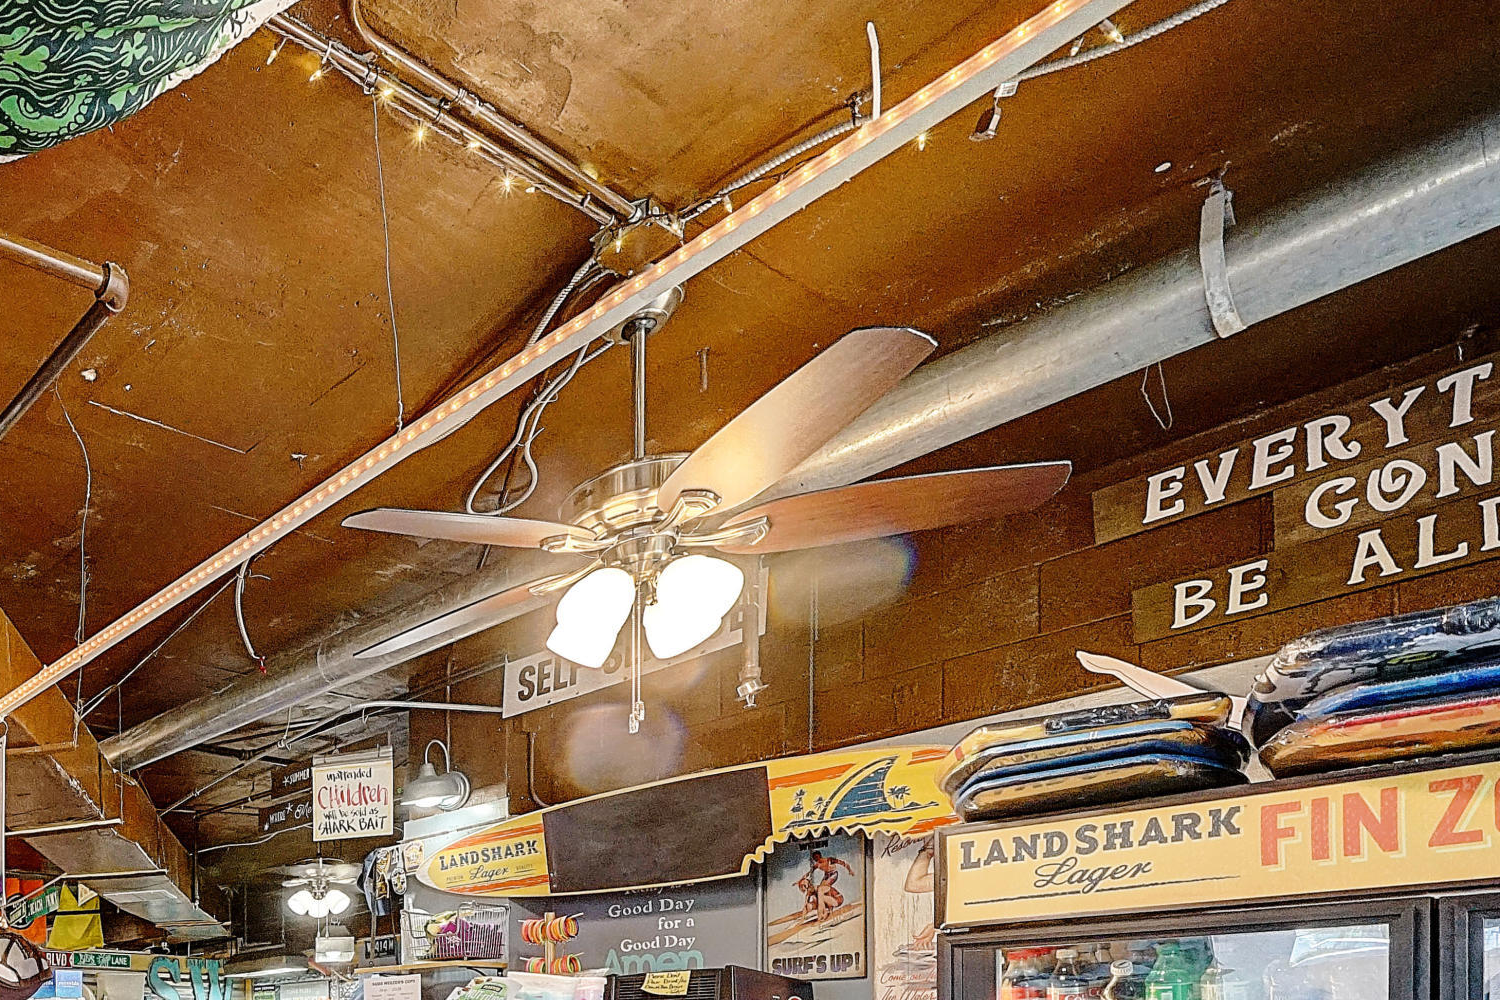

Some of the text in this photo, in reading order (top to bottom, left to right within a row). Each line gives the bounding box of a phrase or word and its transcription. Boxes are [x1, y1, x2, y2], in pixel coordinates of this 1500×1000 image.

[1142, 363, 1492, 525] EVERYT
[1172, 560, 1268, 629] BE
[319, 816, 387, 835] SHARK BAIT
[961, 774, 1500, 871] LANDSHARK FIN Z
[439, 839, 539, 870] LANDSHARK
[1034, 857, 1153, 895] Lager
[608, 899, 695, 918] Good Day
[658, 917, 694, 930] for a
[620, 935, 696, 952] Good Day
[606, 950, 704, 975] Amen
[772, 952, 860, 975] SURF'S UP!
